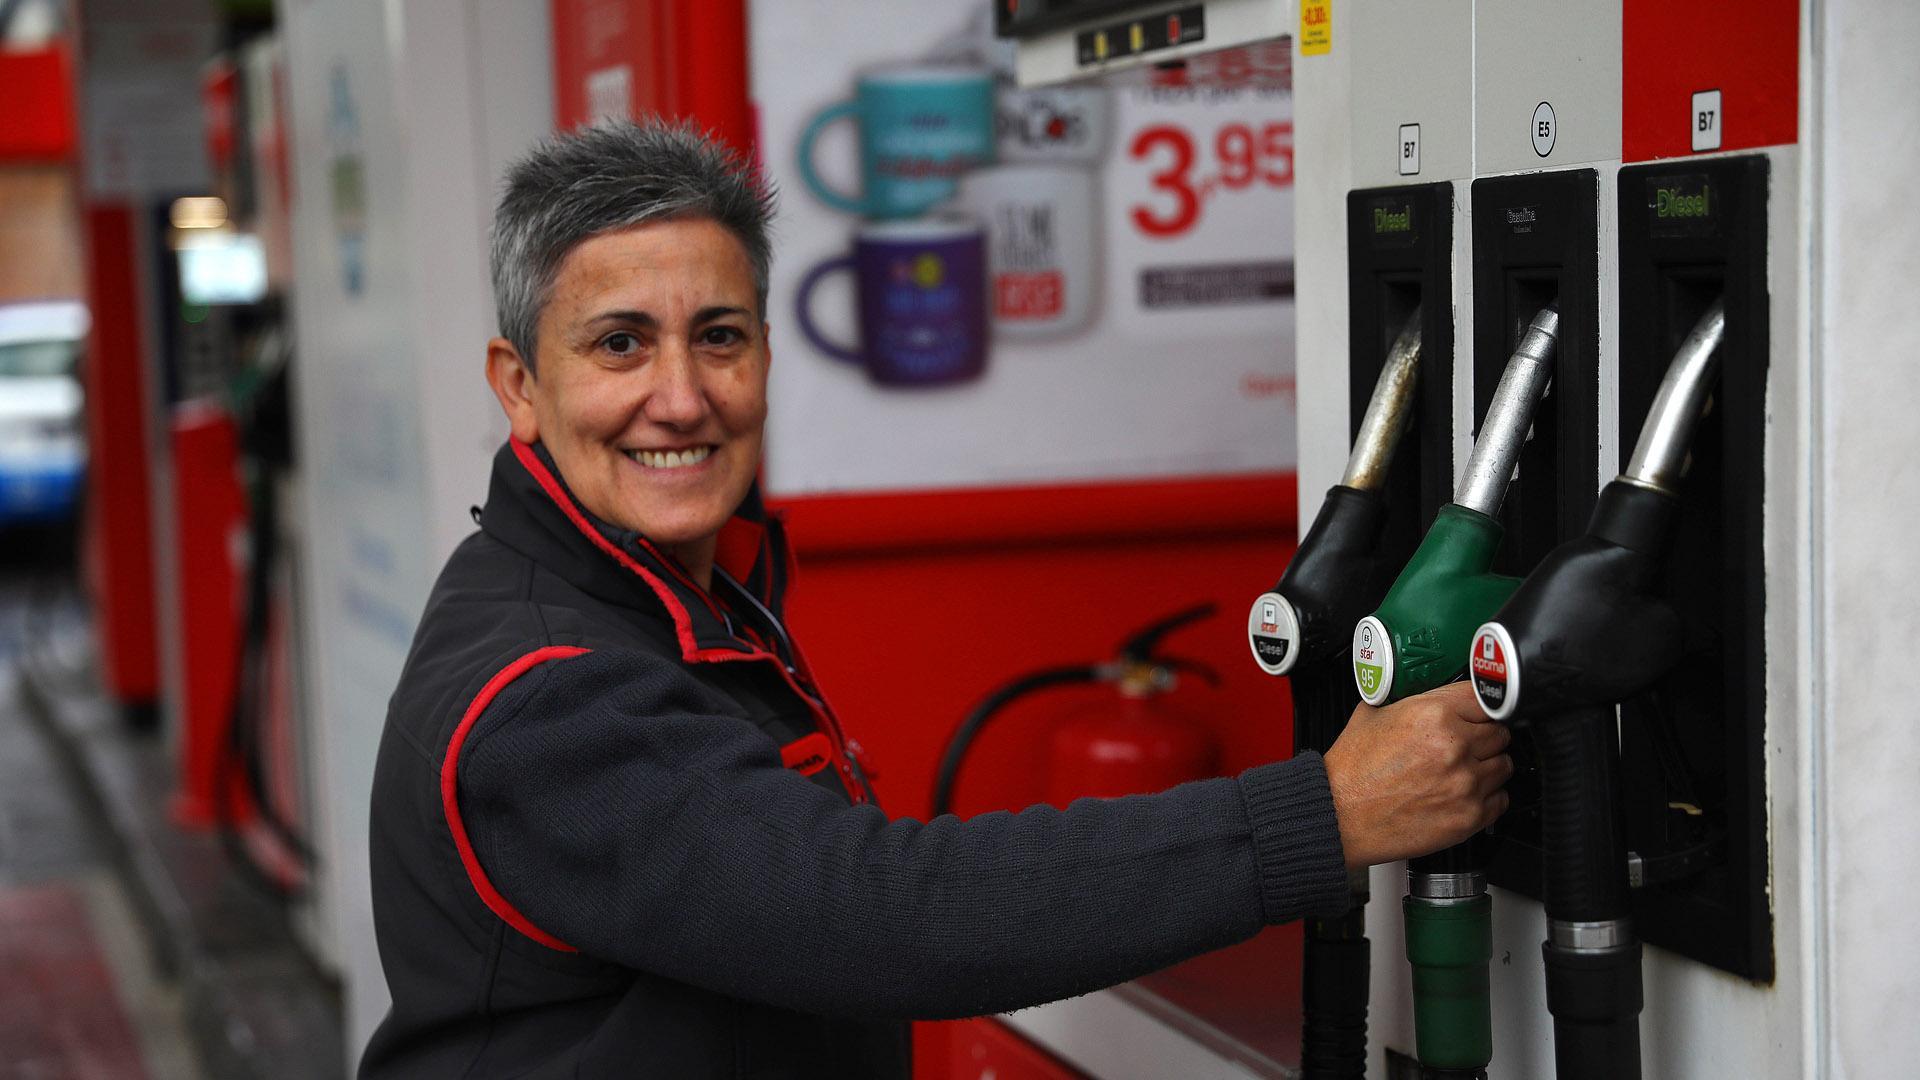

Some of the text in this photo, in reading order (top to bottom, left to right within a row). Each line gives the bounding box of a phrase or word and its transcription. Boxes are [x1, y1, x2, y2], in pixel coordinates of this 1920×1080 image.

[1538, 121, 1550, 138] E5
[1698, 110, 1714, 132] B7
[1404, 141, 1416, 159] B7
[1657, 184, 1708, 218] Diesel
[1374, 204, 1410, 234] Diesel
[1259, 640, 1284, 656] Diesel
[1360, 648, 1375, 661] star
[1474, 656, 1505, 674] optima
[1361, 668, 1374, 689] 95
[1479, 680, 1503, 700] Diesel
